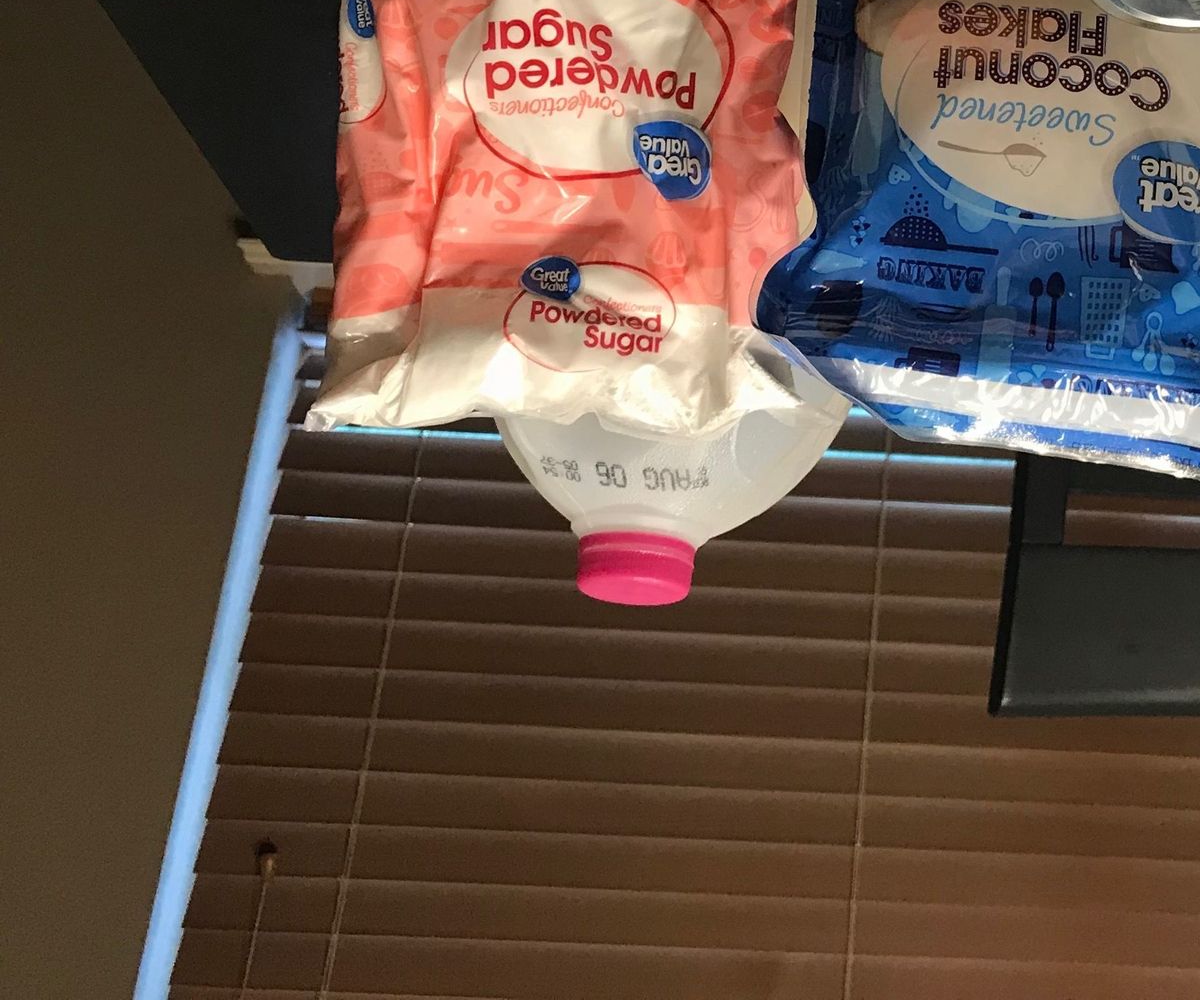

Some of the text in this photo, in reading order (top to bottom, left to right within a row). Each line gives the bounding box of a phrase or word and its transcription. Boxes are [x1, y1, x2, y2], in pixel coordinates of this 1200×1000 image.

[481, 8, 613, 63] Sugar
[937, 1, 1107, 57] Flakes
[484, 57, 697, 110] Powdered
[933, 46, 1170, 112] Coconut
[489, 90, 625, 118] Confectioners
[930, 93, 1116, 146] Sweetened
[639, 135, 690, 158] Value
[641, 150, 701, 185] Grea
[530, 267, 571, 283] Great
[540, 280, 568, 292] Value
[877, 256, 985, 295] BAKING
[529, 300, 662, 333] Powdered
[583, 325, 663, 356] Sugar
[595, 461, 627, 488] 06
[642, 467, 692, 492] AUG
